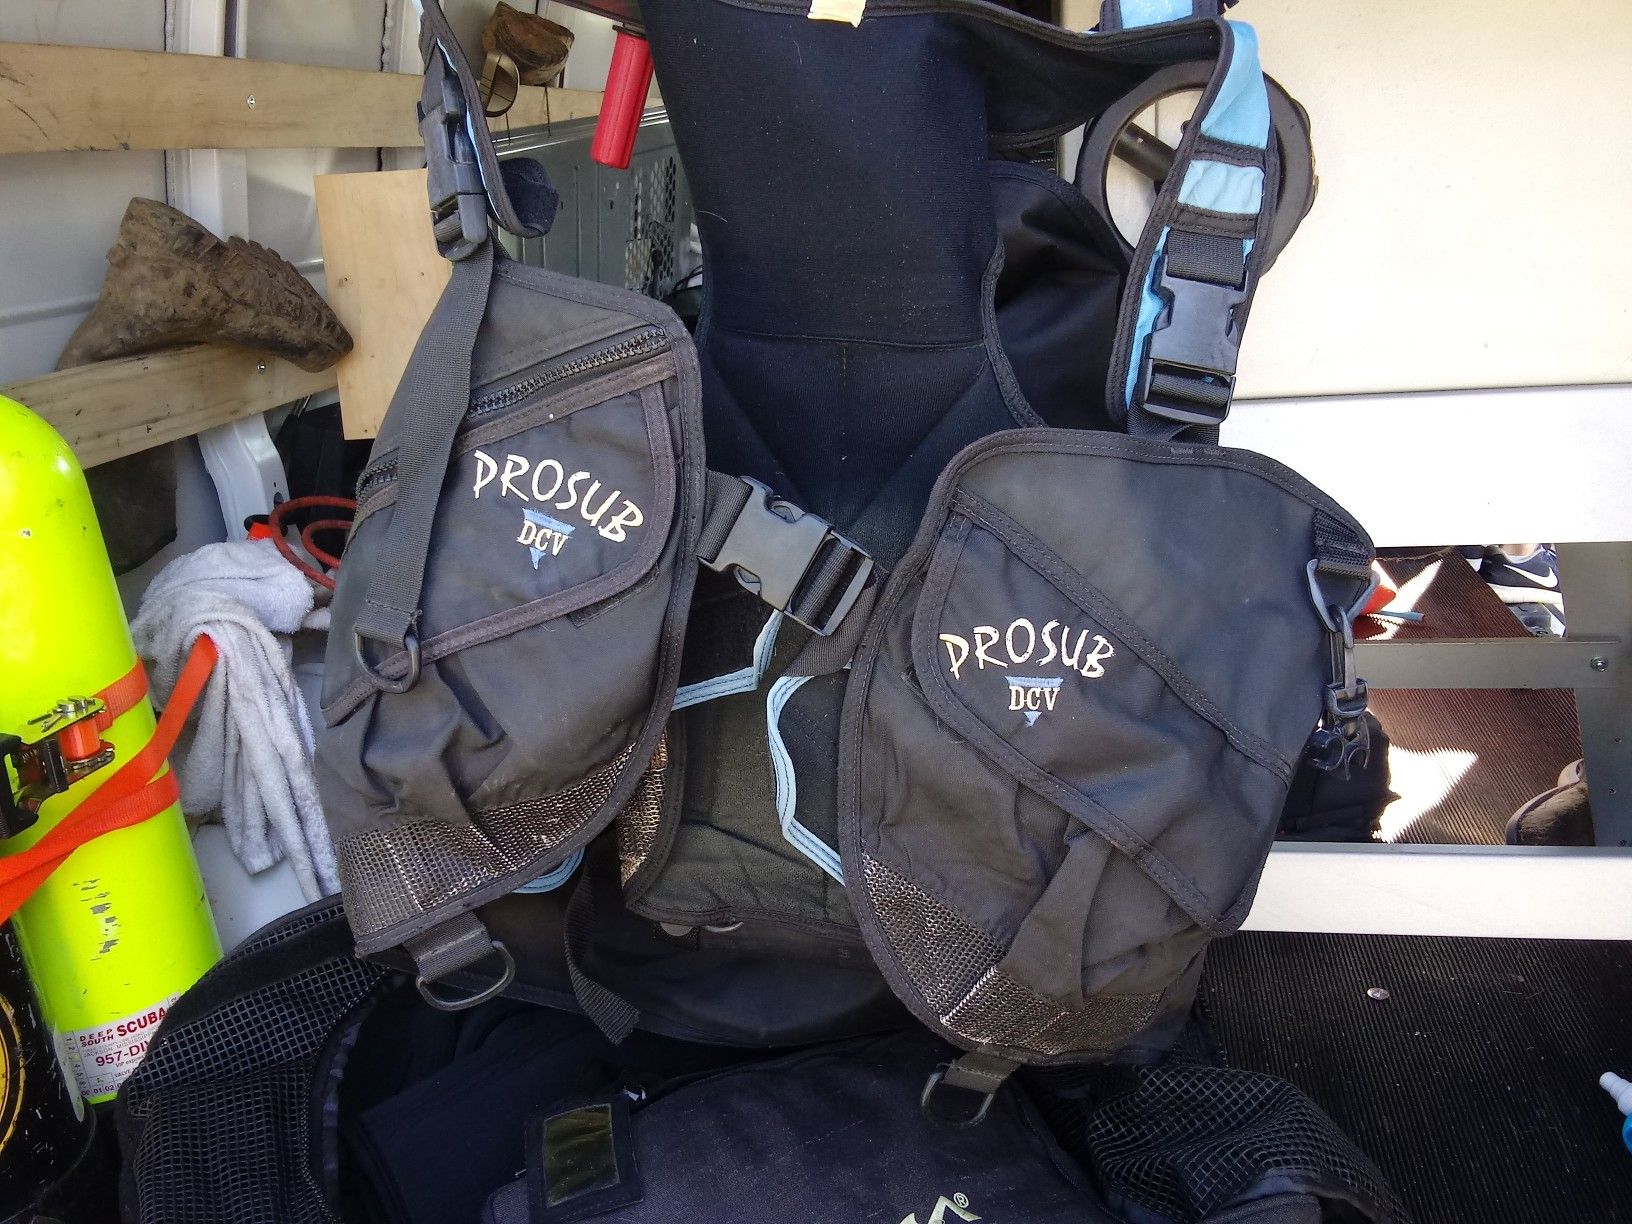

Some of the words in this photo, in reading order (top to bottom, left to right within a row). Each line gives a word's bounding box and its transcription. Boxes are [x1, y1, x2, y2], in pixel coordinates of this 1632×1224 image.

[473, 450, 644, 542] PROSUB
[516, 520, 570, 556] DCV
[939, 618, 1116, 678] PROSUB
[1008, 685, 1061, 711] DCV
[80, 1029, 112, 1042] DEEP
[117, 1007, 166, 1037] SCUBA
[81, 1034, 114, 1048] SOUTH
